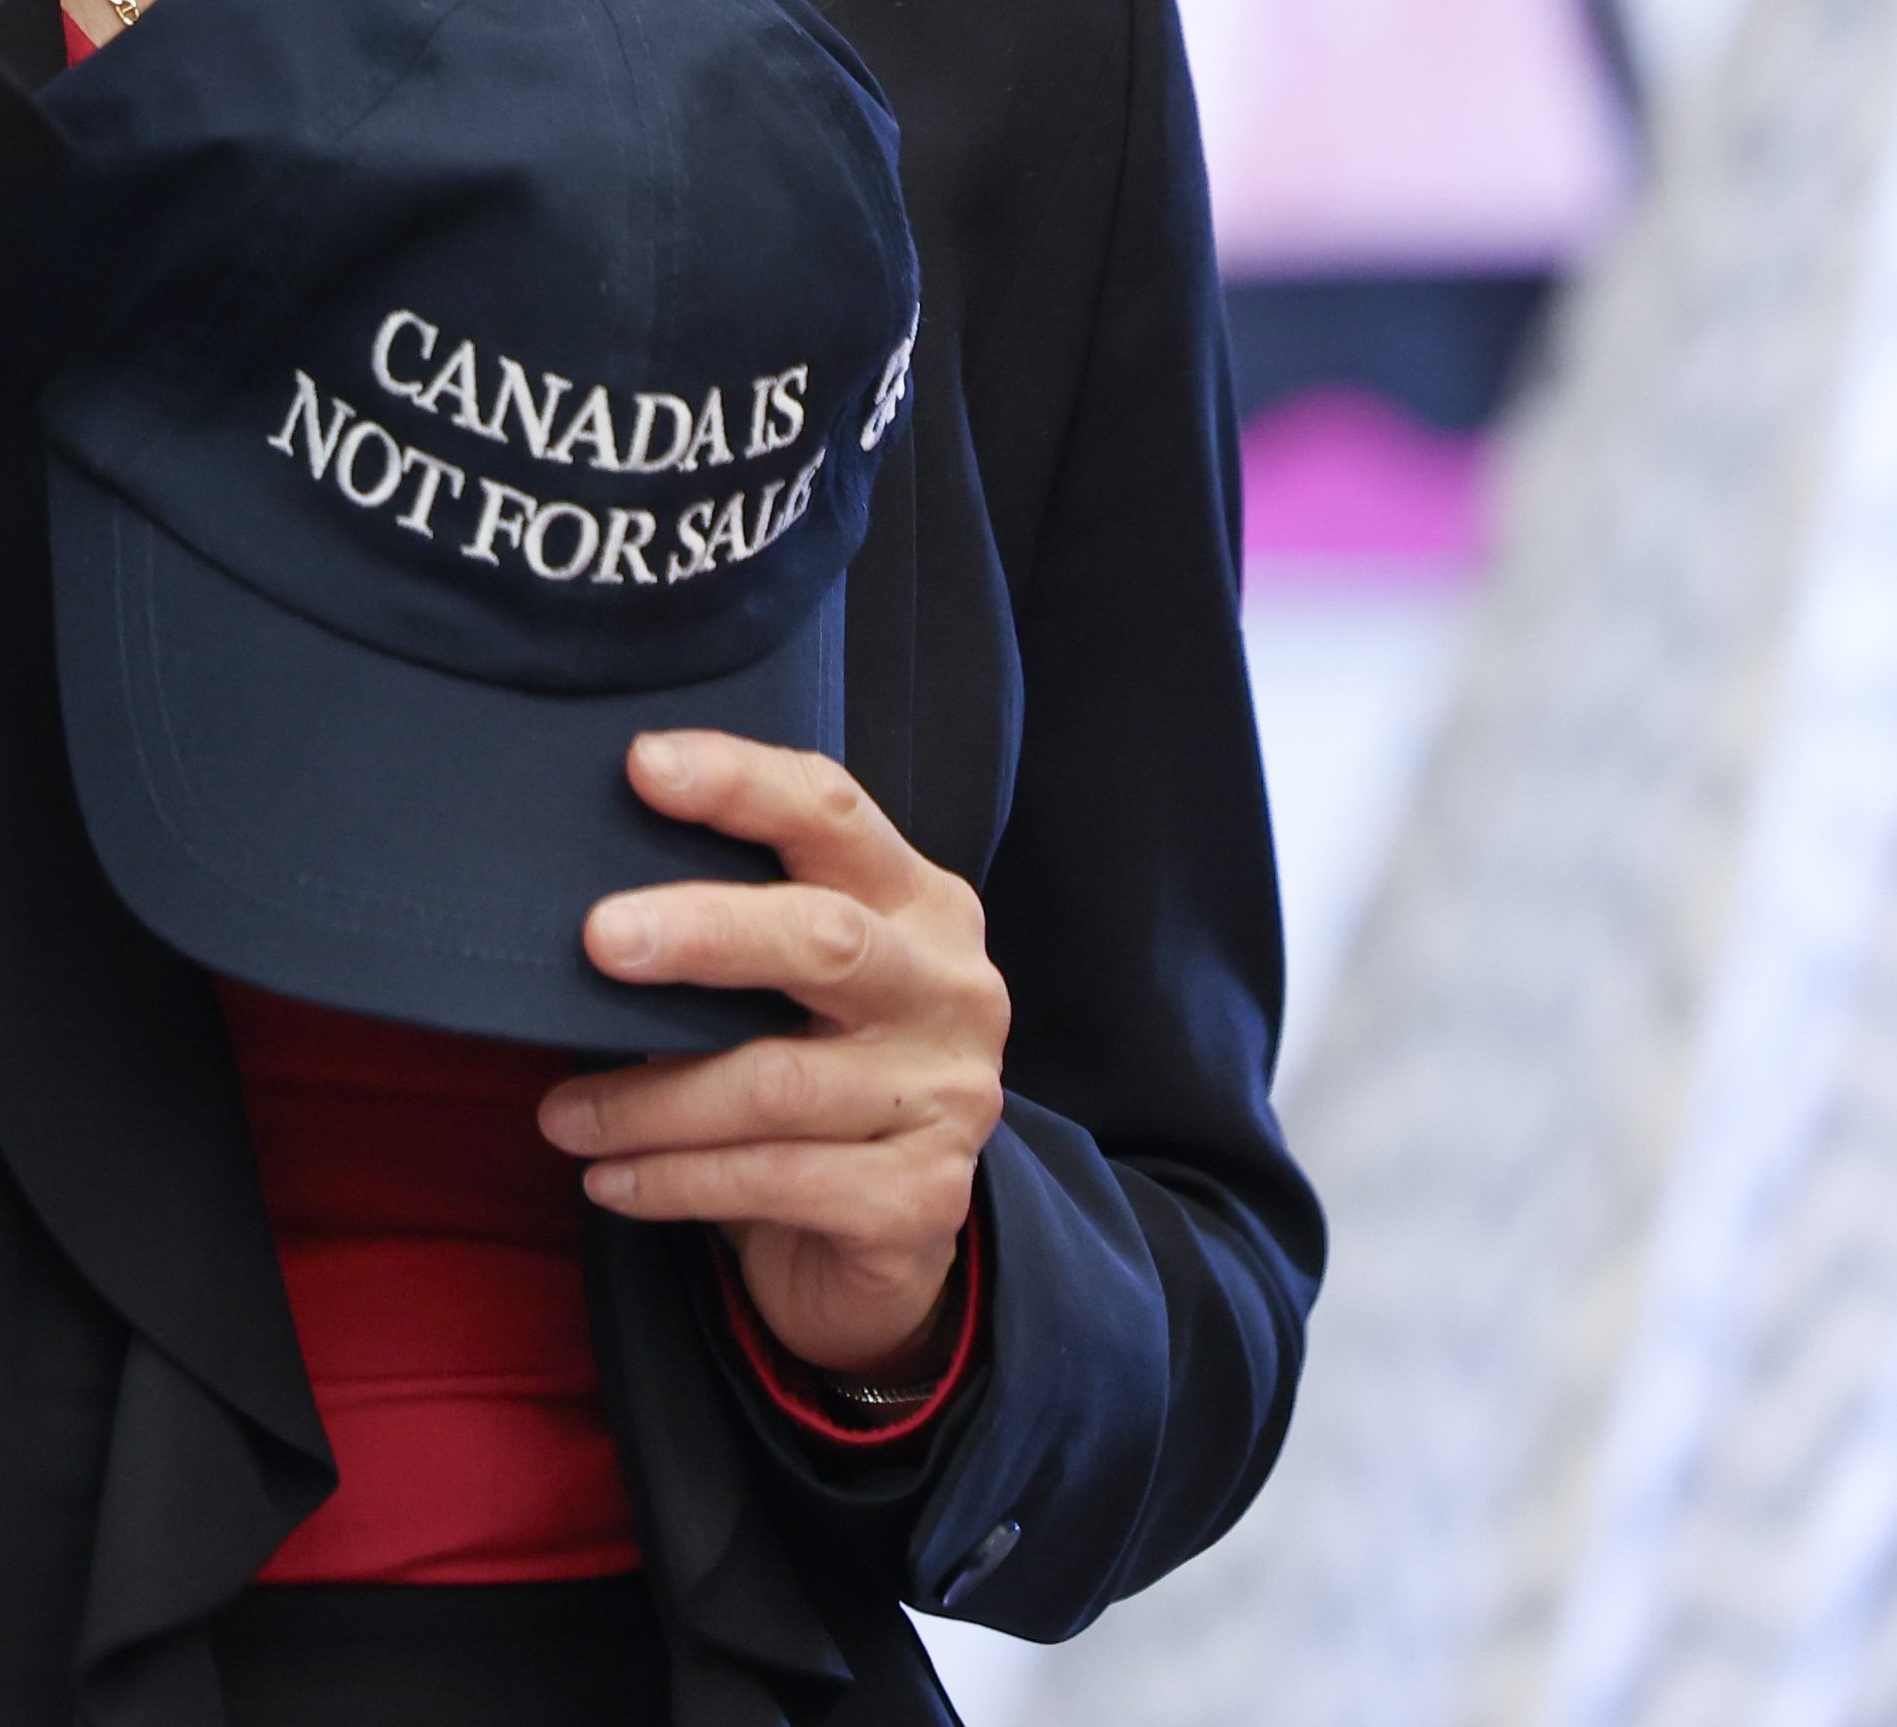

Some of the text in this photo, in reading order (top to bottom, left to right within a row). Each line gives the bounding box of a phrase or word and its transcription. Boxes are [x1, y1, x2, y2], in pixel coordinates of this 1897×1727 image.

[268, 370, 463, 538] NOT
[461, 481, 658, 584] FOR
[372, 310, 734, 472] CANADA
[745, 365, 808, 459] IS
